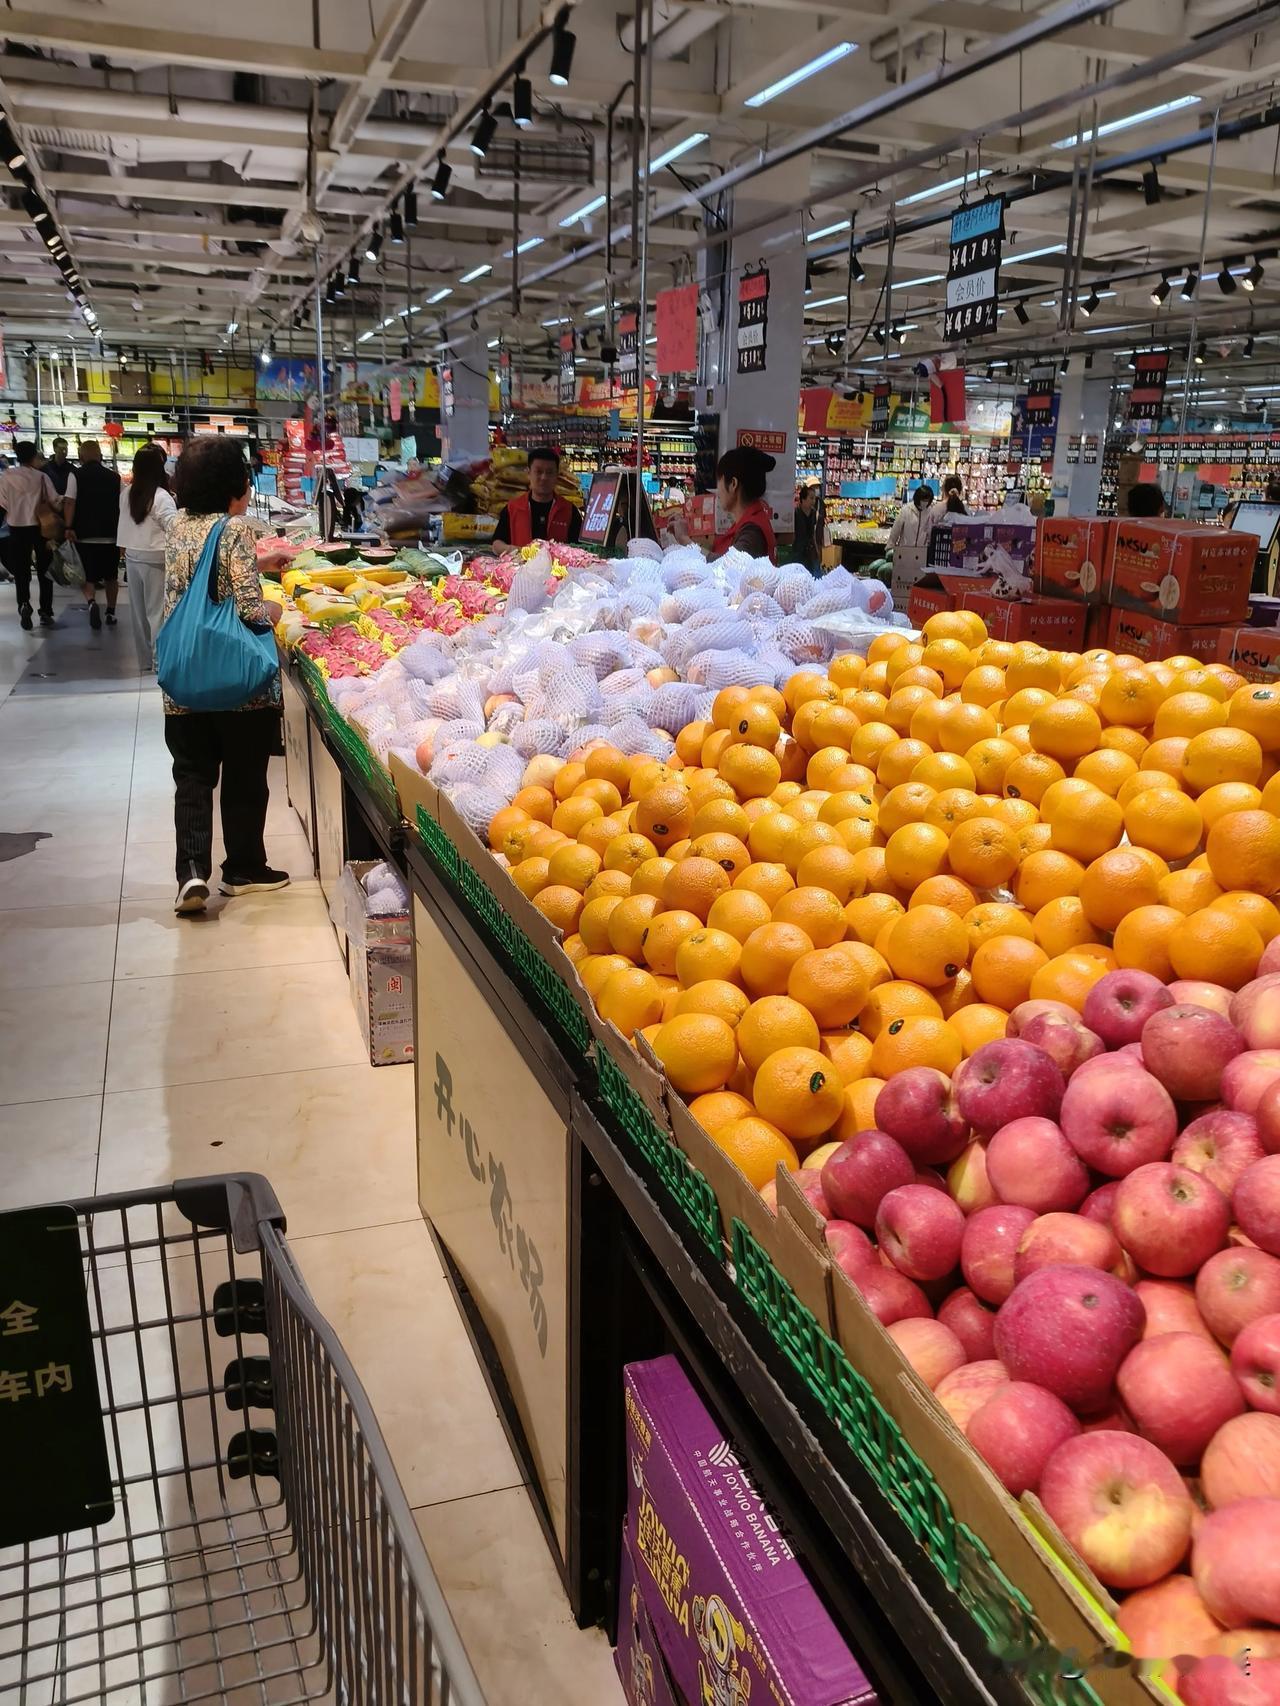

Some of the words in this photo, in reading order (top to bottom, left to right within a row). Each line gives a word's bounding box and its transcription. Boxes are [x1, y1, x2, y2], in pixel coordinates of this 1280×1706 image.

[955, 276, 986, 301] 会员价
[0, 1300, 40, 1337] 全
[722, 1472, 751, 1511] JOYVIO
[746, 1512, 781, 1566] BANANA
